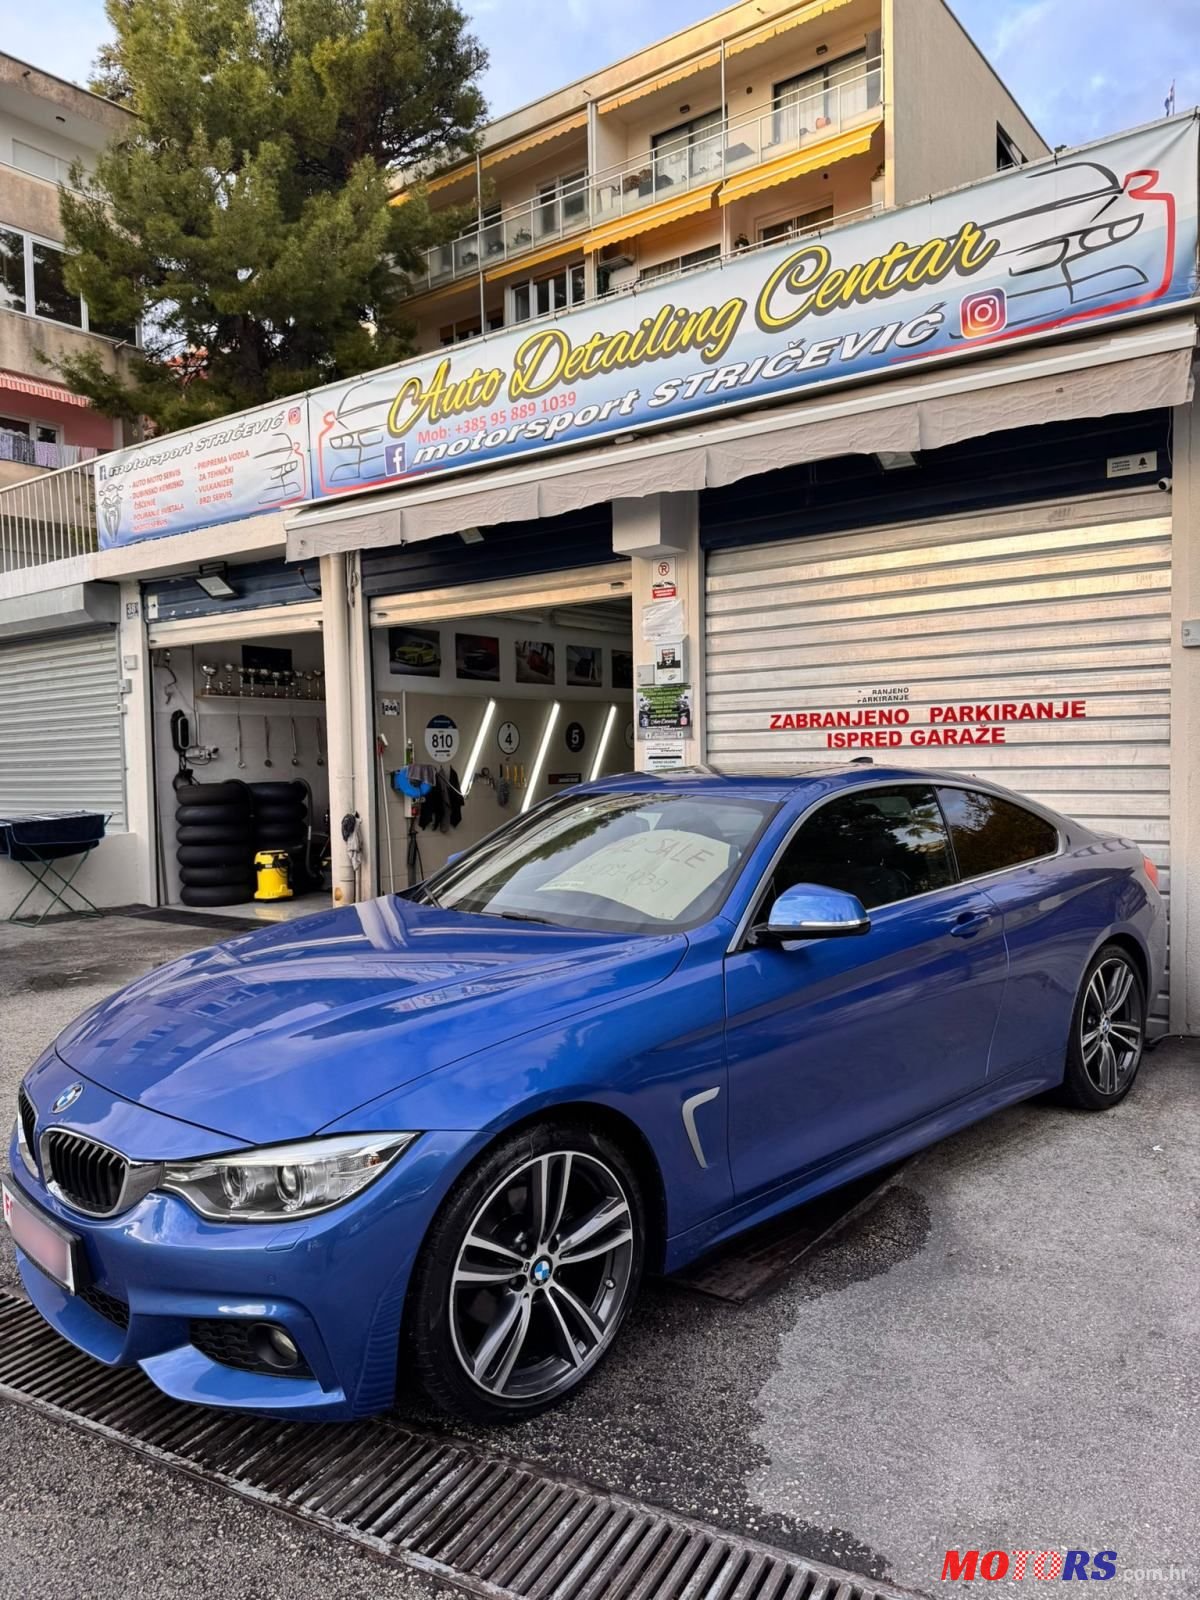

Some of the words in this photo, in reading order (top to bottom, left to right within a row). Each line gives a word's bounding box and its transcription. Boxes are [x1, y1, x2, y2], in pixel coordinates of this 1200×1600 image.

[388, 358, 506, 438] Auto
[508, 297, 748, 402] Detailing
[755, 221, 1000, 333] Centar
[412, 388, 641, 465] motorsport
[647, 302, 946, 408] STRIČEVIĆ
[417, 428, 452, 444] Mob:
[455, 415, 487, 434] +385
[490, 410, 507, 427] 95
[511, 402, 537, 421] 889
[541, 391, 577, 415] 1039
[108, 441, 194, 478] motorsport
[195, 410, 286, 453] STRIČEVIĆ
[770, 708, 910, 730] ZABRANJENO
[929, 701, 1087, 724] PARKIRANJE
[431, 733, 453, 748] 810
[504, 732, 513, 746] 4
[571, 729, 580, 744] 5
[827, 729, 903, 749] ISPRED
[910, 723, 1006, 748] GARAŽE
[644, 837, 716, 869] SALE
